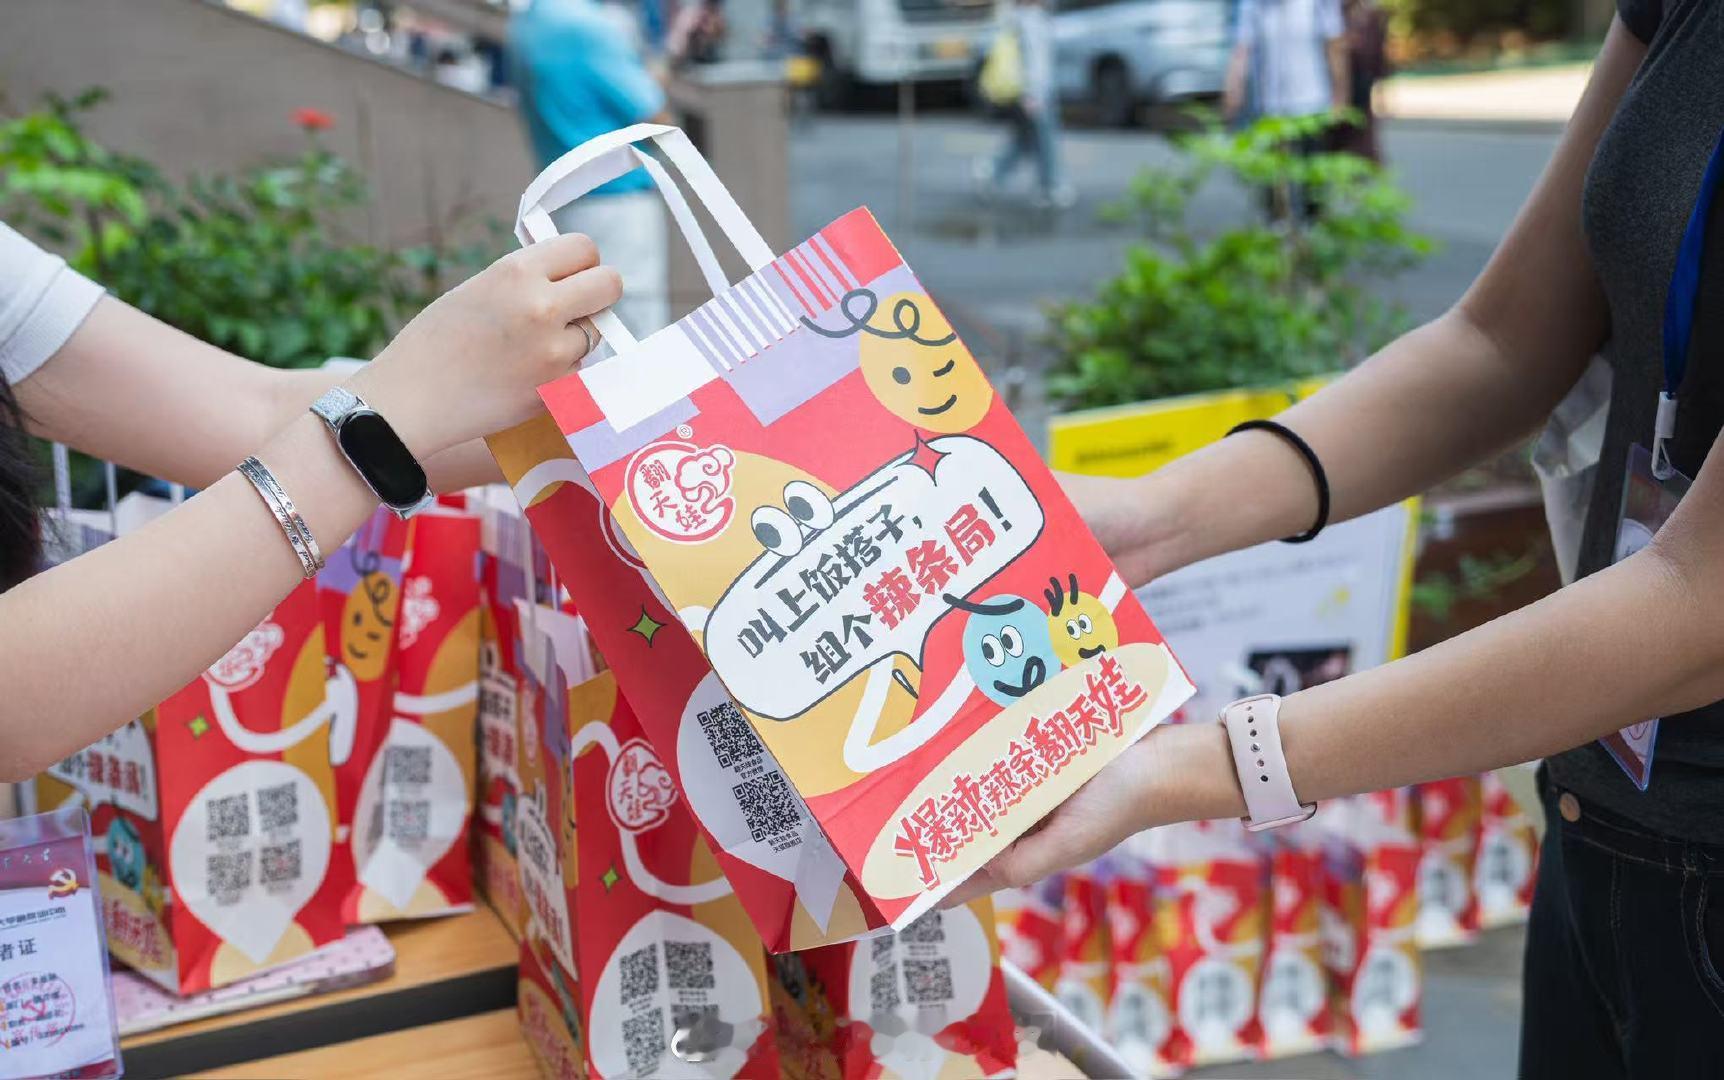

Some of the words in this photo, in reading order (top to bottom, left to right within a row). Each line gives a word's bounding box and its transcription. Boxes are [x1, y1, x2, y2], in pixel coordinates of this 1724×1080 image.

[639, 459, 708, 532] 翻天娃
[737, 504, 922, 659] 叫上饭搭子，
[799, 486, 1013, 685] 组个辣条局！
